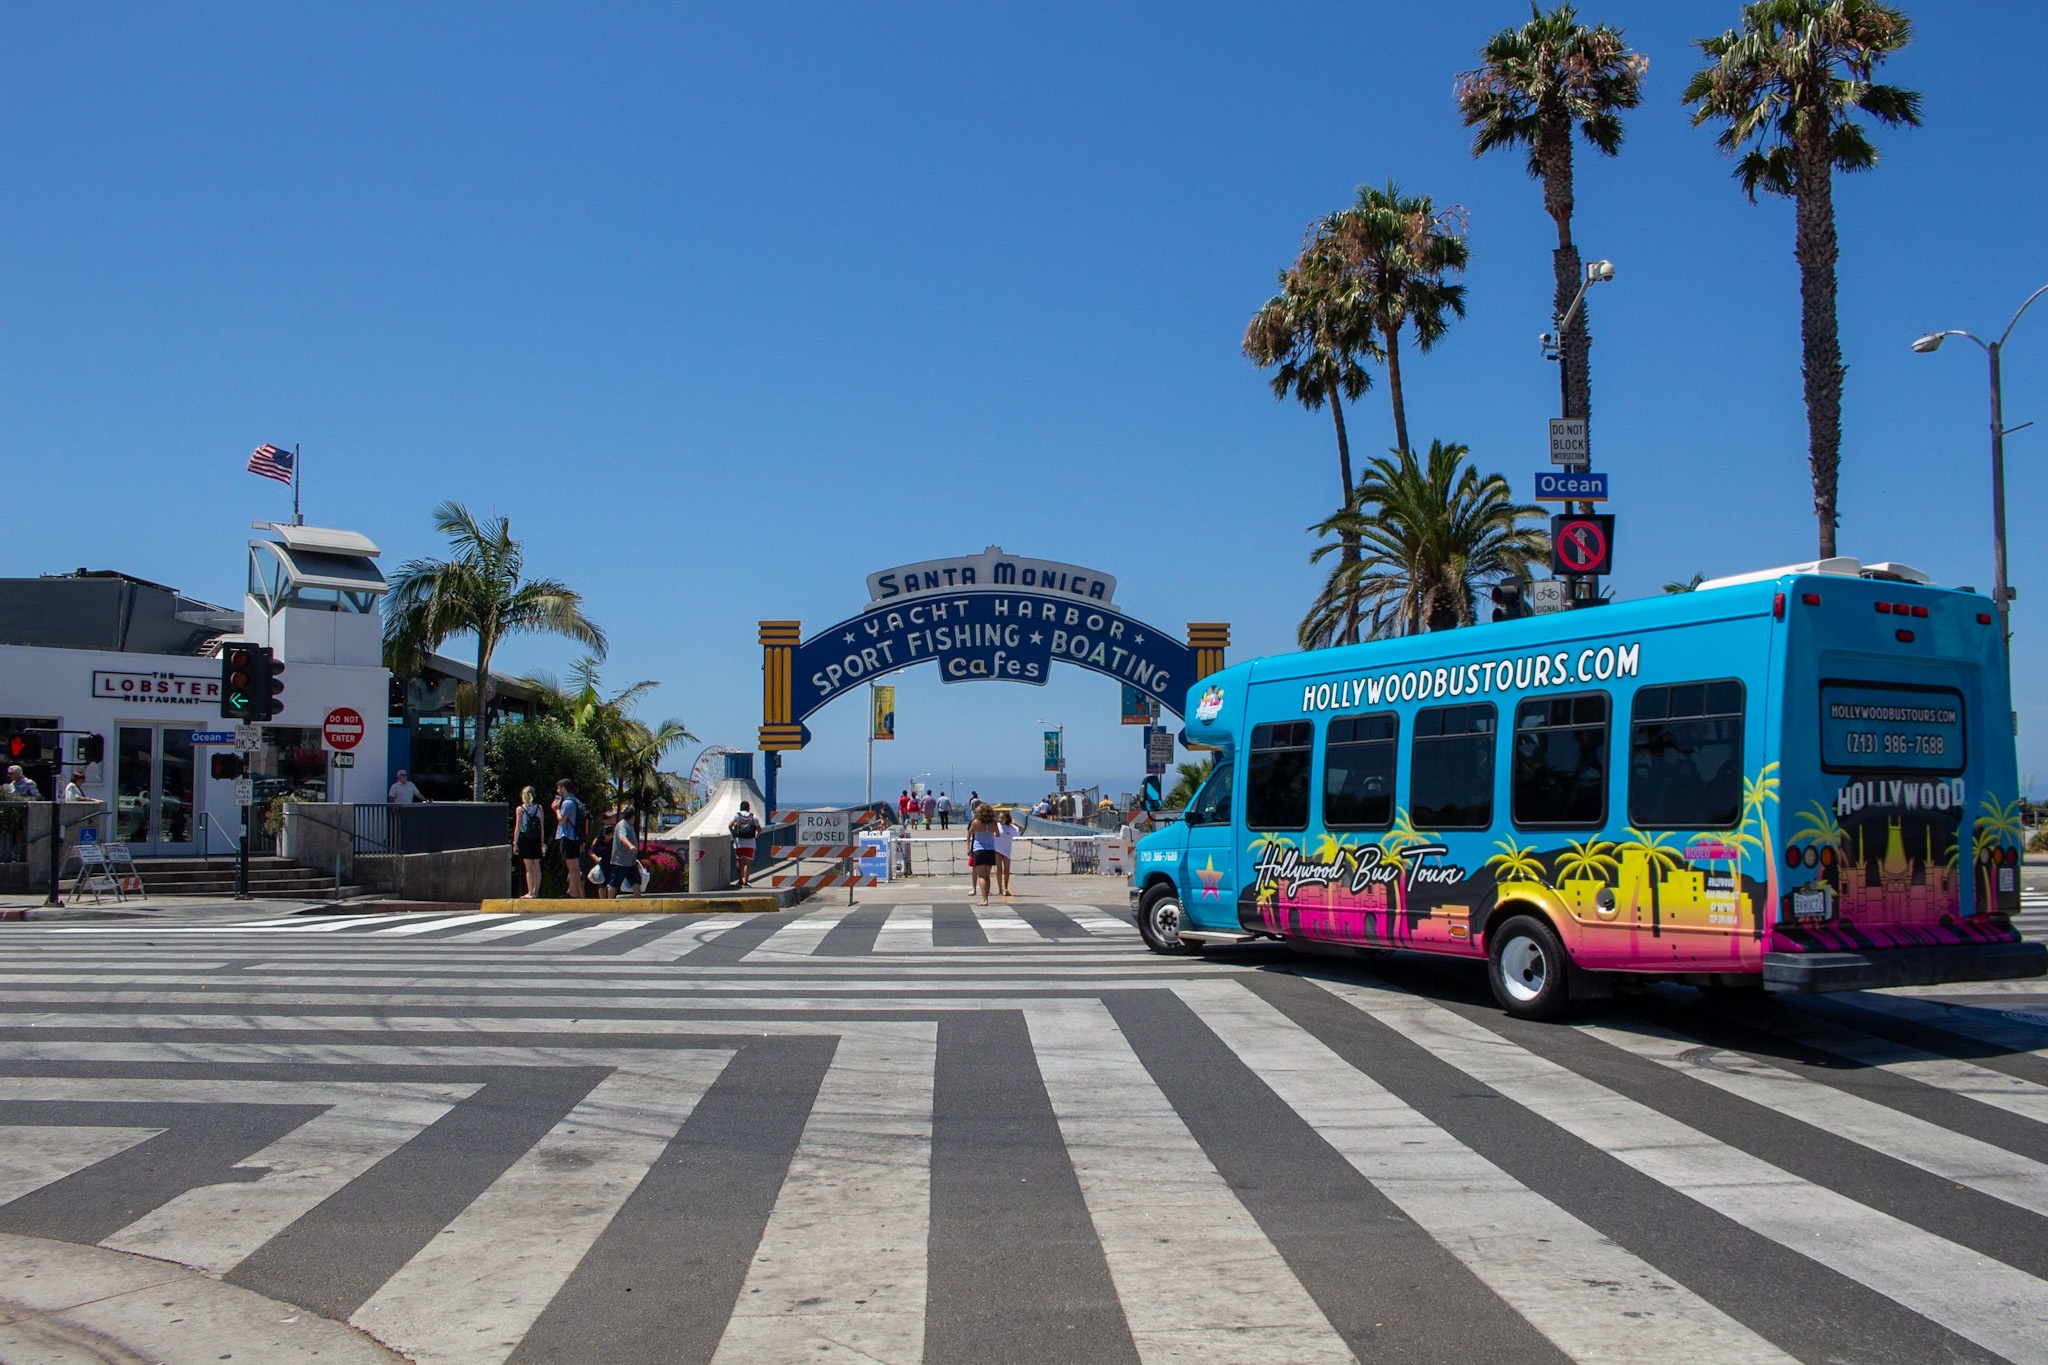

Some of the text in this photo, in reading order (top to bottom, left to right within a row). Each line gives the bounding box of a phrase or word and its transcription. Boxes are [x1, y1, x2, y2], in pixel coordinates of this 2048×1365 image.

[1552, 424, 1583, 435] DO NOT
[1553, 439, 1584, 450] BLOCK
[1553, 452, 1585, 460] INTERSECTION
[1541, 475, 1603, 492] Ocean
[878, 562, 1106, 599] SANTA MONICA
[1536, 605, 1559, 614] SIGNAL
[863, 599, 1126, 640] YACHT HARBOR
[812, 624, 1171, 696] SPORT FISHING BOATING
[152, 671, 175, 680] THE
[1302, 643, 1641, 712] HOLLYWOODBUSTOURS.COM
[105, 679, 219, 696] LOBSTER
[123, 695, 200, 704] RESTAURANT
[1831, 704, 1956, 722] HOLLYWOODBUSTOURS.COM
[330, 715, 340, 723] DO
[191, 732, 222, 742] Ocean
[331, 734, 355, 742] ENTER
[236, 739, 246, 750] OK
[1846, 733, 1944, 754] (213) 986-7688
[1837, 778, 1965, 816] HOLLYWOOD
[807, 817, 840, 826] ROAD
[1686, 848, 1711, 858] RODEO
[1255, 844, 1465, 898] Hollywood Bus Tours
